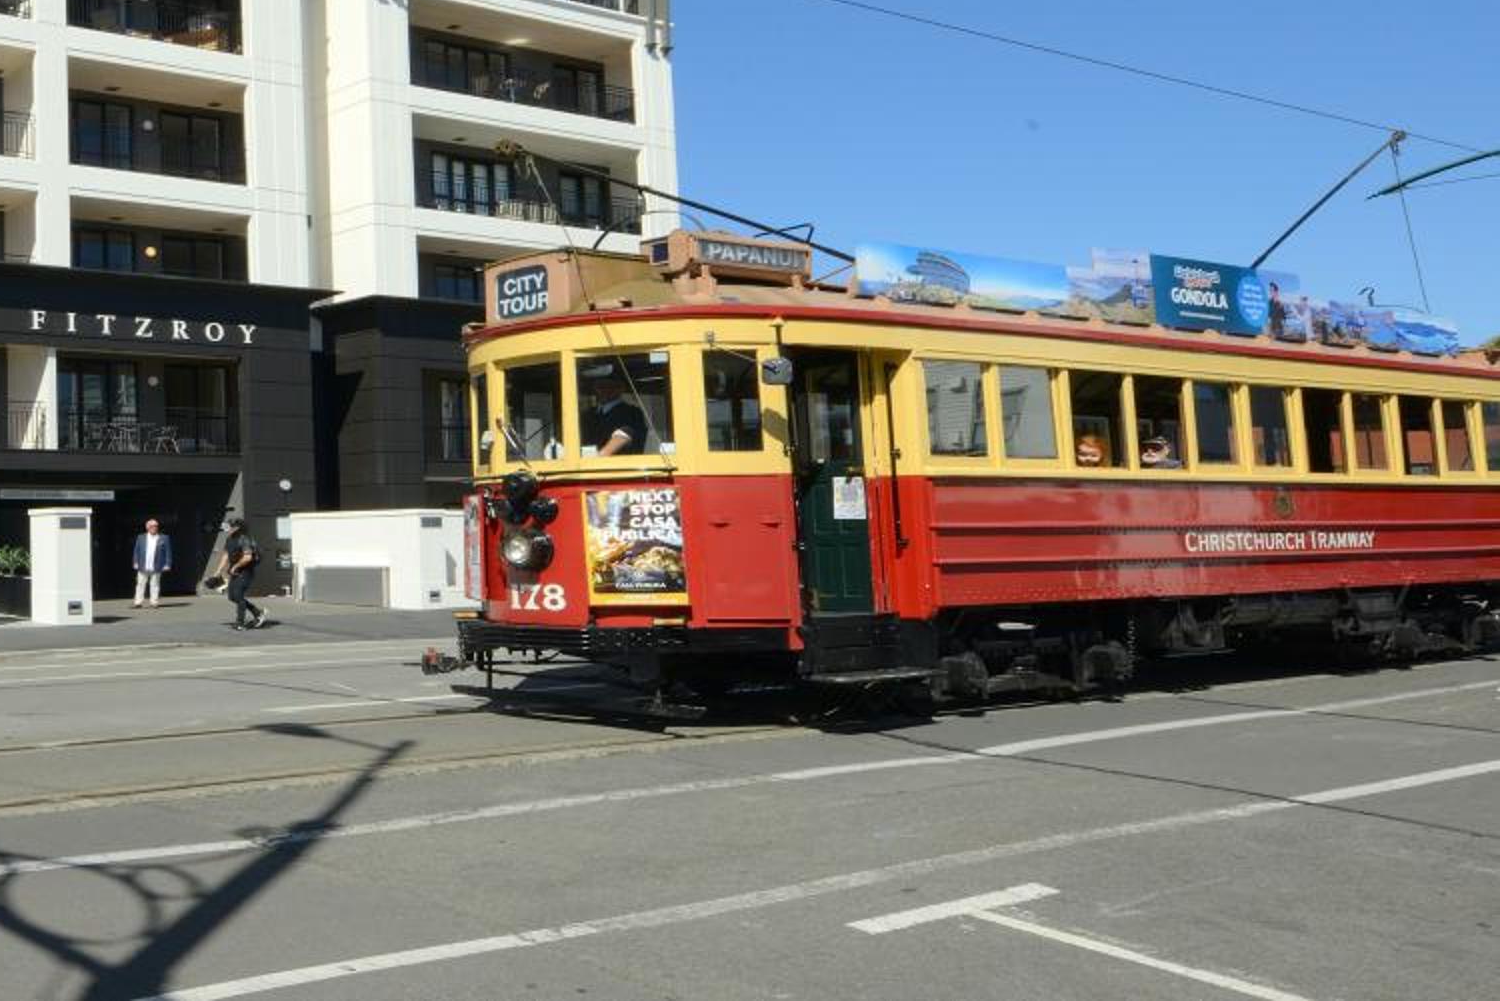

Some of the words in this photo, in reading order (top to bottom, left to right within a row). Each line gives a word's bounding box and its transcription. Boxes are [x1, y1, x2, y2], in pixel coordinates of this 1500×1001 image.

[707, 242, 799, 267] PAPANUI
[503, 271, 545, 296] CITY
[499, 291, 549, 316] TOUR
[1171, 287, 1229, 310] GONDOLA
[30, 309, 257, 344] FITZROY
[629, 503, 676, 516] STOP
[629, 516, 678, 529] CASA
[1185, 531, 1305, 552] CHRISTCHURCH
[1311, 530, 1375, 550] TRAMWAY
[510, 583, 567, 612] 178
